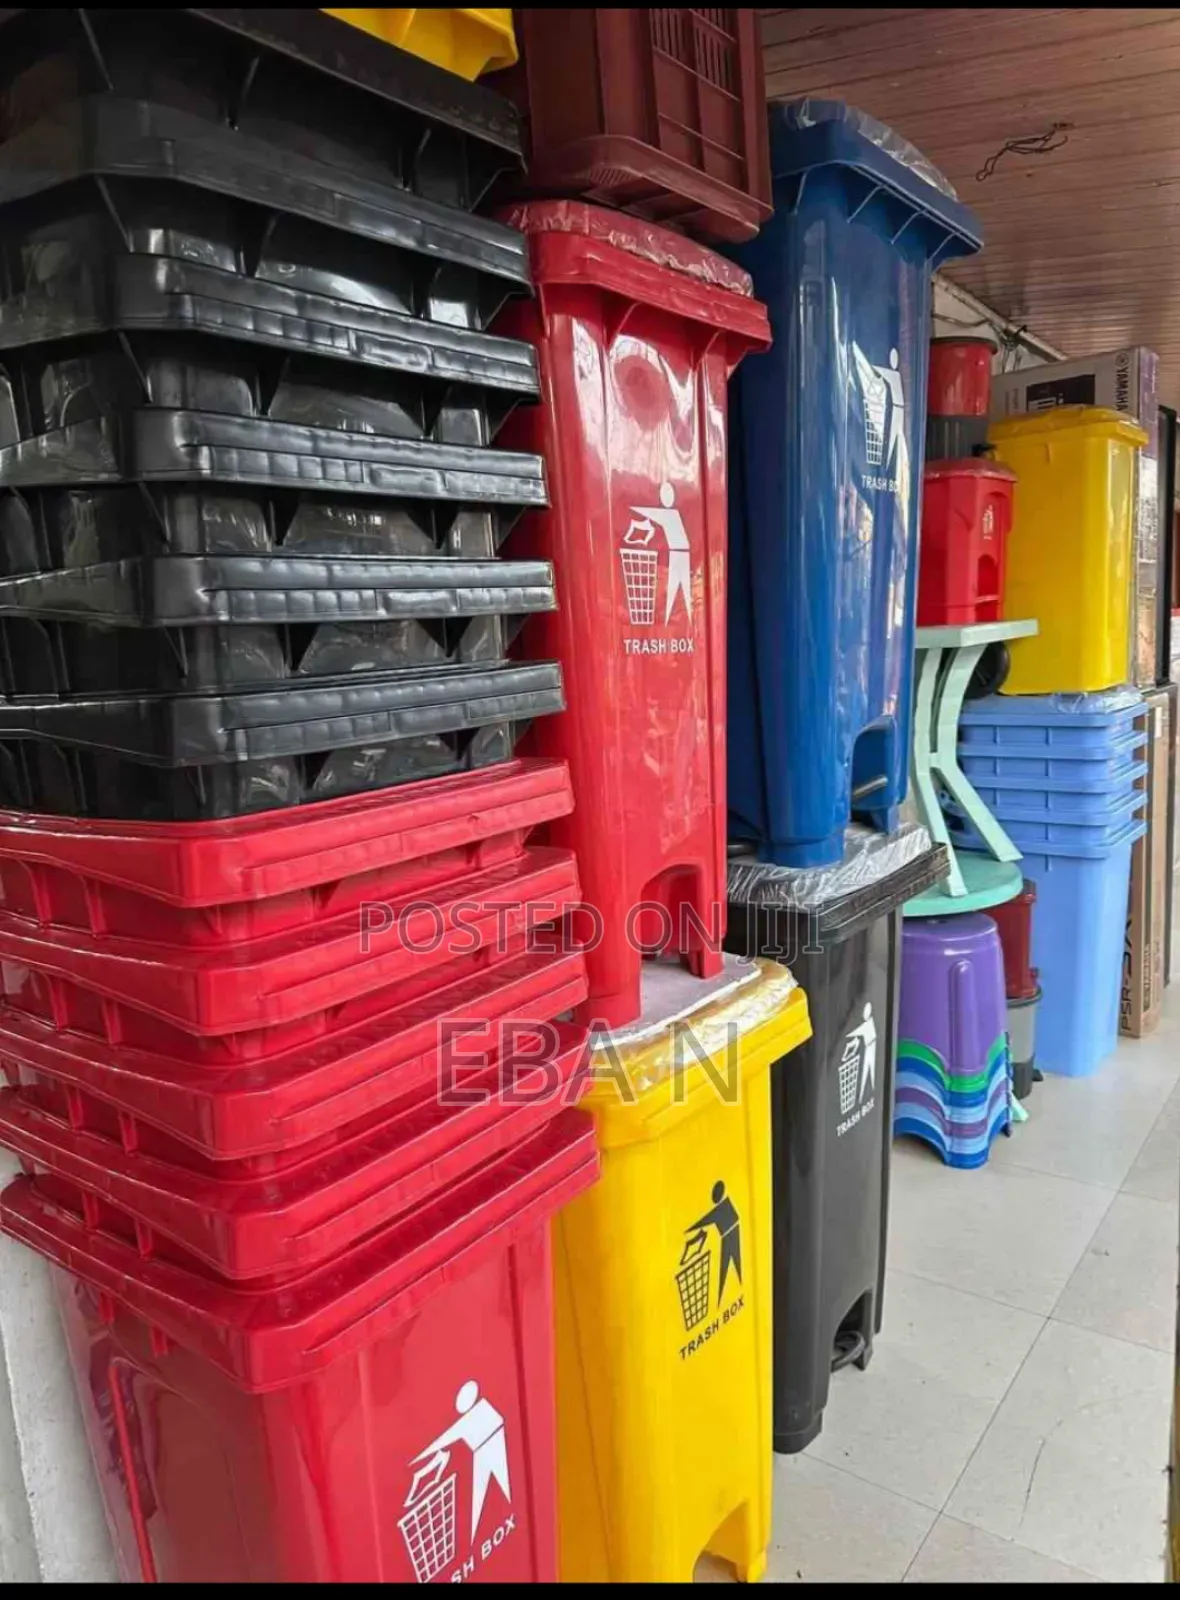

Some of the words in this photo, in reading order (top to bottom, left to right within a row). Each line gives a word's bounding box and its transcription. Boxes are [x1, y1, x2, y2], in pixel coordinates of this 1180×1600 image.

[1115, 366, 1129, 411] YAMAHA
[862, 474, 887, 492] TRASH
[623, 638, 666, 654] TRASH
[670, 638, 694, 653] BOX
[836, 1110, 860, 1137] TRASH
[862, 1097, 875, 1117] BOX
[679, 1317, 719, 1361] TRASH
[722, 1294, 744, 1324] BOX
[481, 1513, 516, 1560] BOX
